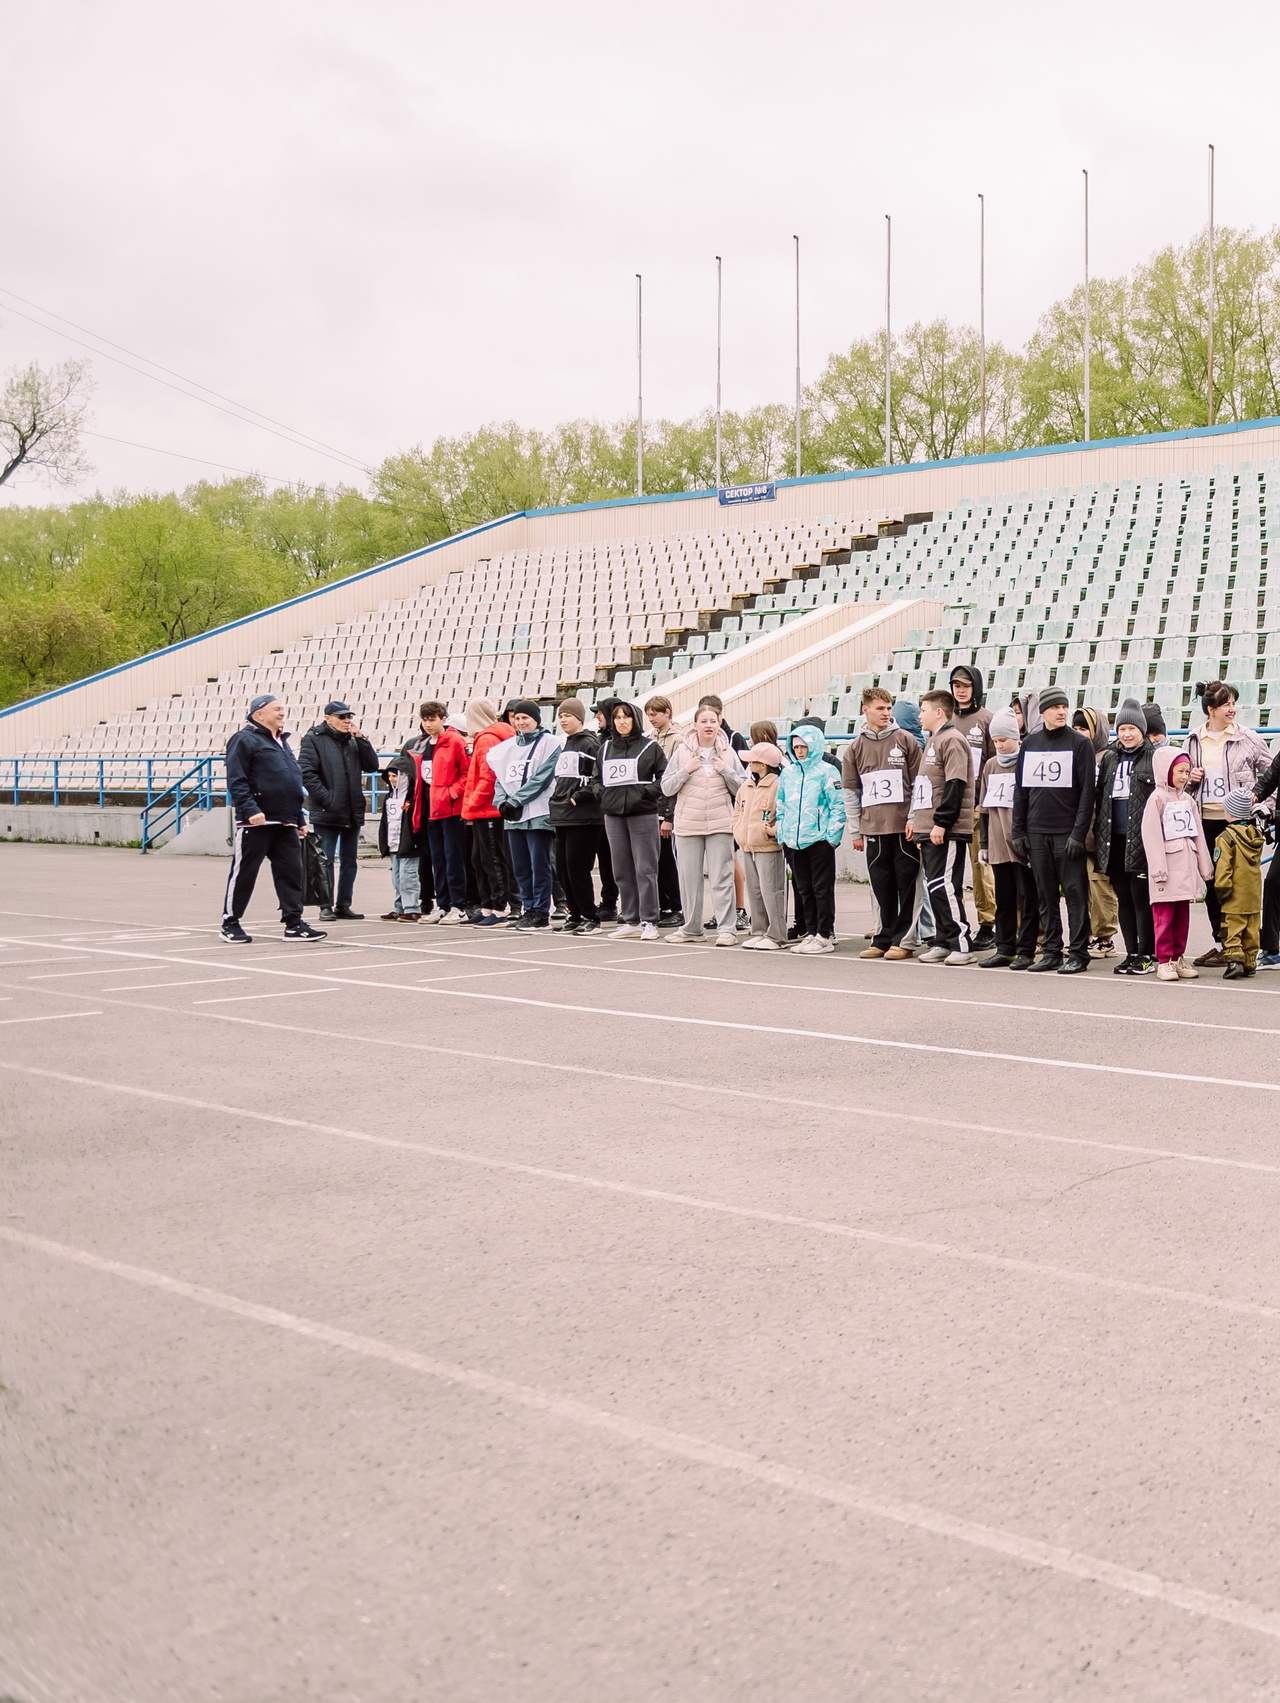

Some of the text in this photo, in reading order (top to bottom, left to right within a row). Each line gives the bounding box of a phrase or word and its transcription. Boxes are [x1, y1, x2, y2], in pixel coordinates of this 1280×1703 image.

[726, 488, 753, 498] СЕКТОР
[425, 766, 432, 779] 2
[609, 764, 627, 779] 29
[1032, 760, 1062, 782] 49
[868, 779, 893, 800] 43
[1202, 777, 1226, 798] 48
[761, 809, 772, 822] K
[1172, 810, 1193, 832] 52
